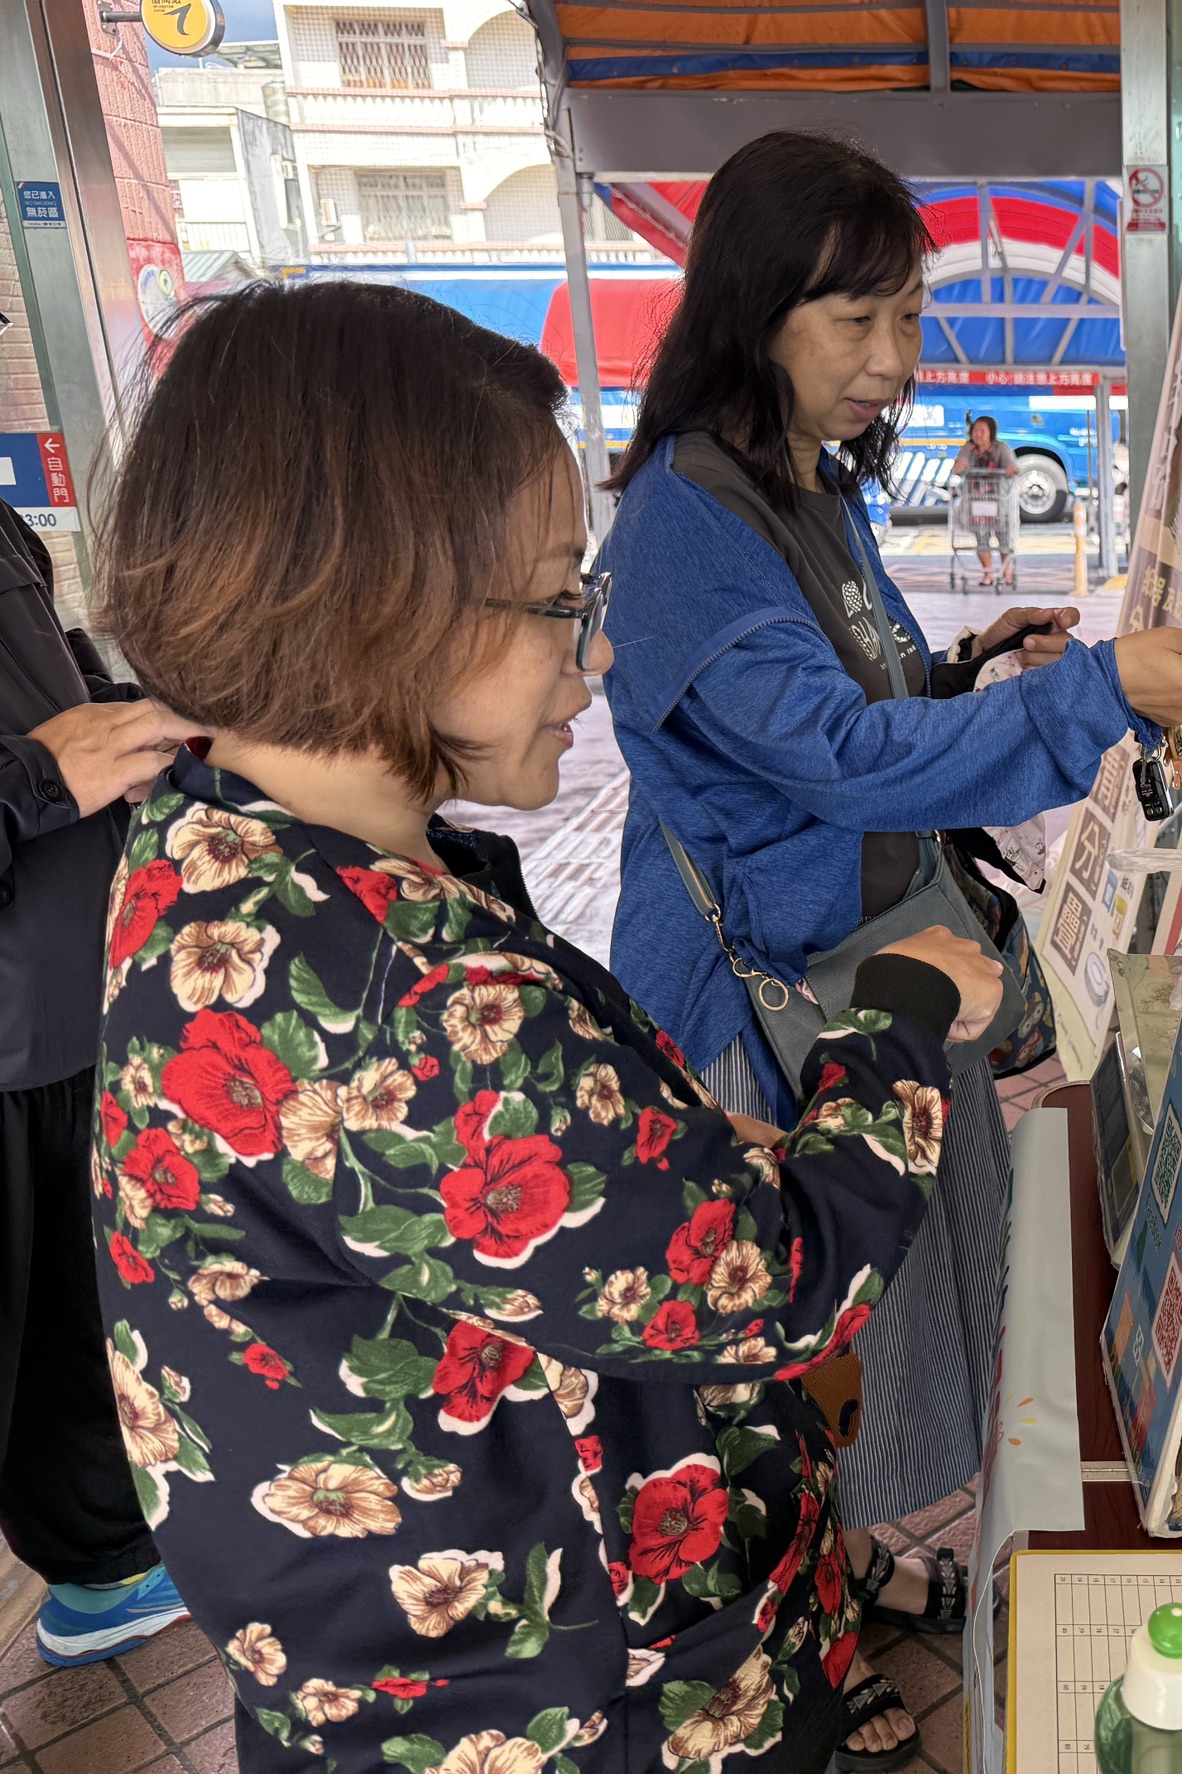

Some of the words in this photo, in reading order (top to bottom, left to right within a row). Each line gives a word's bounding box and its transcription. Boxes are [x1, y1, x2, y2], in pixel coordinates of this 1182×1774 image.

[26, 206, 59, 218] 無菸區
[47, 457, 70, 503] 自動門
[20, 513, 57, 527] 3:00
